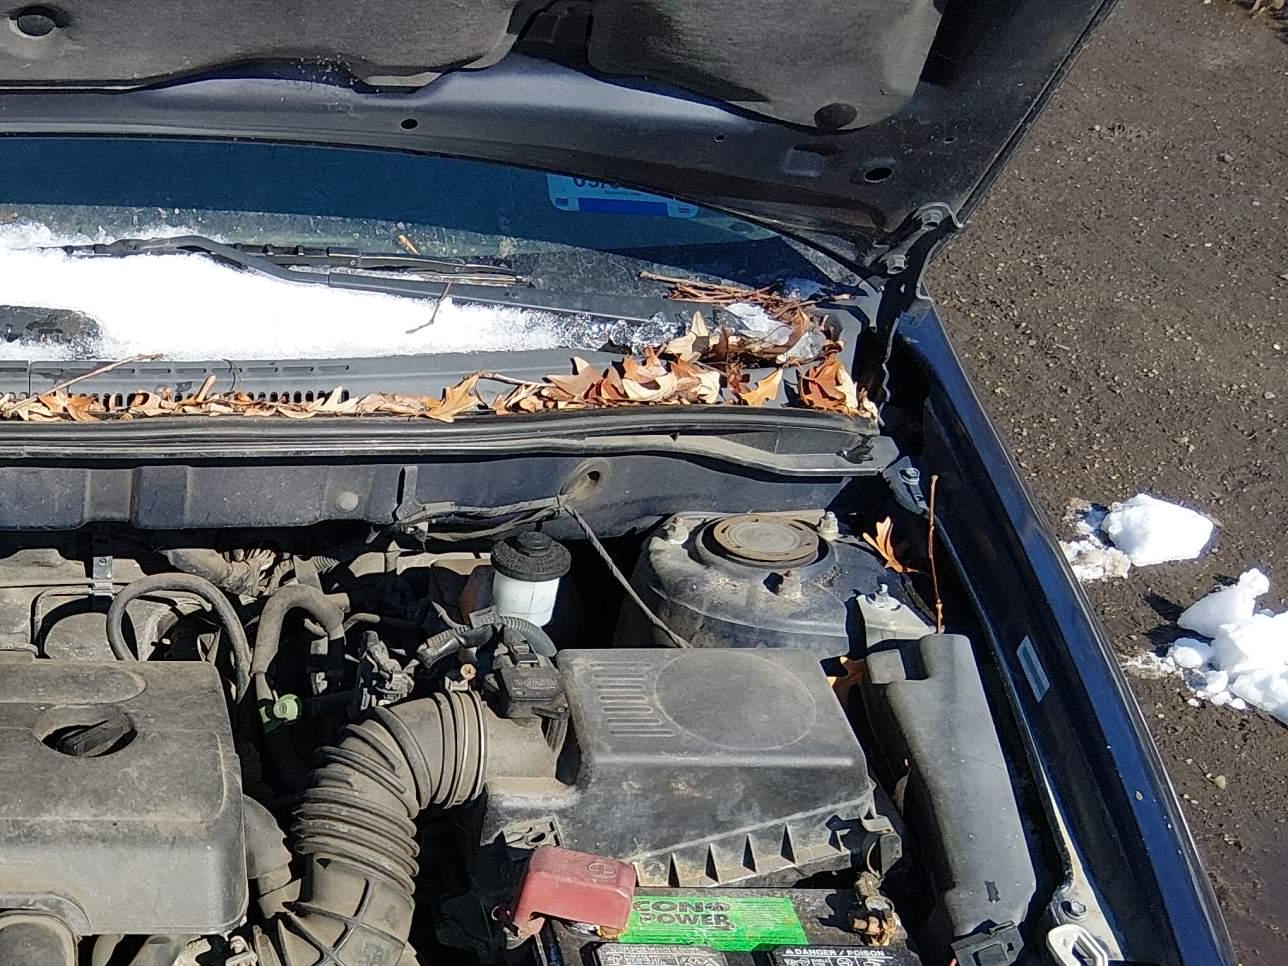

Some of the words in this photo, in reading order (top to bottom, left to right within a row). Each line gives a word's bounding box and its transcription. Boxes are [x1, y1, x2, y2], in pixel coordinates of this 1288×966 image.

[632, 900, 731, 912] CONO
[639, 912, 734, 929] POWER
[794, 948, 838, 956] DANGER
[846, 948, 886, 957] POISON
